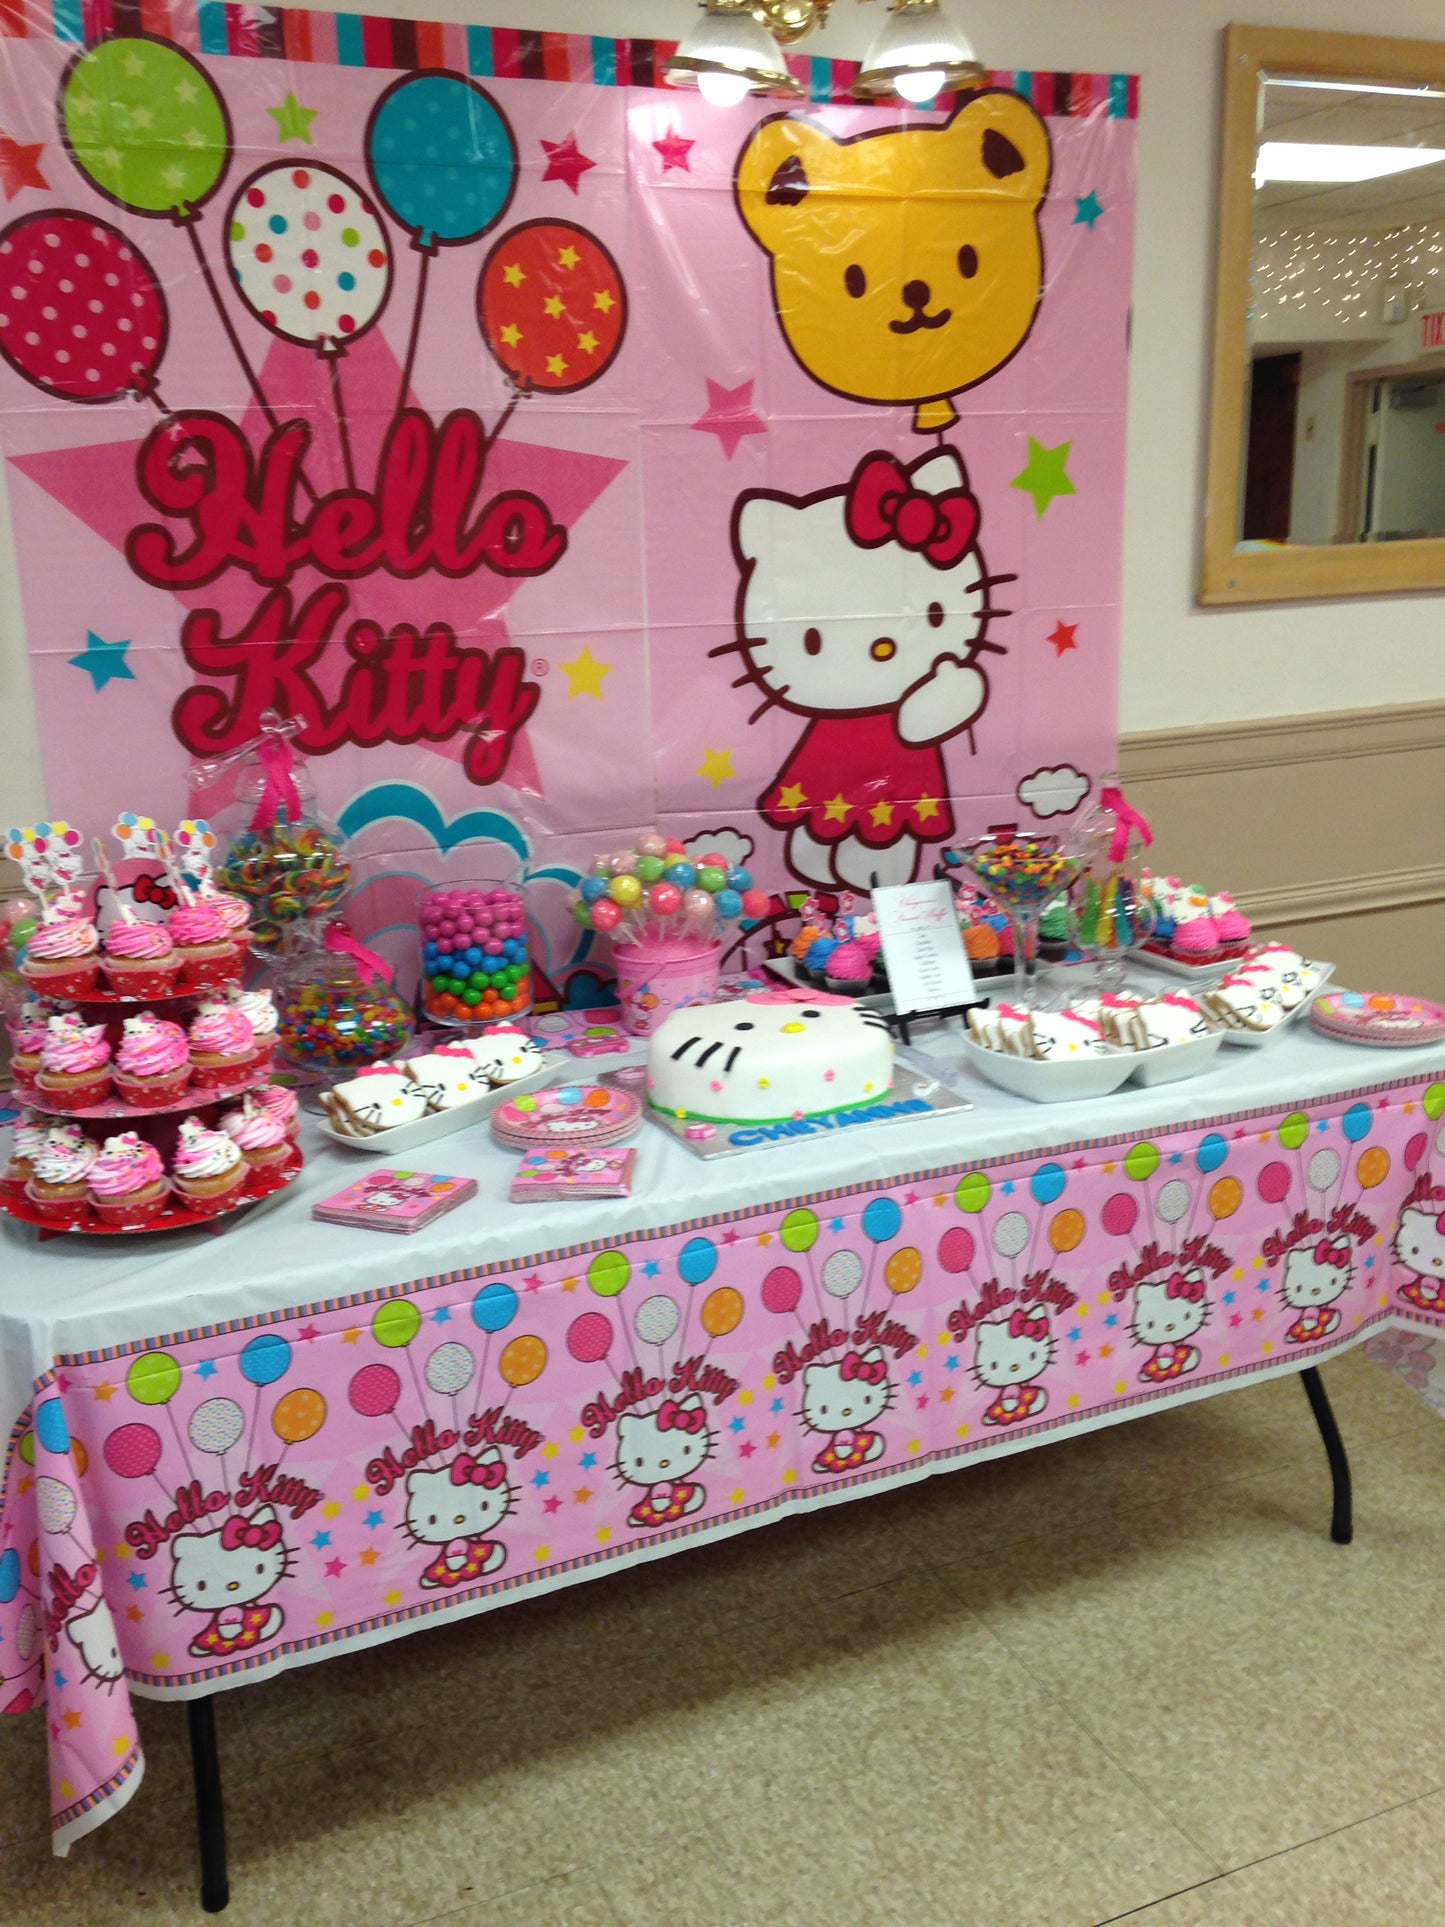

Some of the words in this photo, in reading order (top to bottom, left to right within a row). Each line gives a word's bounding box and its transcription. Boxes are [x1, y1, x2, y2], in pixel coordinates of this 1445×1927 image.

[126, 408, 568, 590] Hello
[172, 582, 541, 786] Kitty
[773, 1318, 849, 1384] Hello
[852, 1310, 918, 1360] Kitty
[948, 1277, 1016, 1343] Hello
[581, 1366, 666, 1439] Hello
[669, 1354, 739, 1406] Kitty
[366, 1418, 460, 1496] Hello
[463, 1405, 543, 1460] Kitty
[125, 1479, 231, 1560] Hello
[235, 1463, 322, 1520] Kitty
